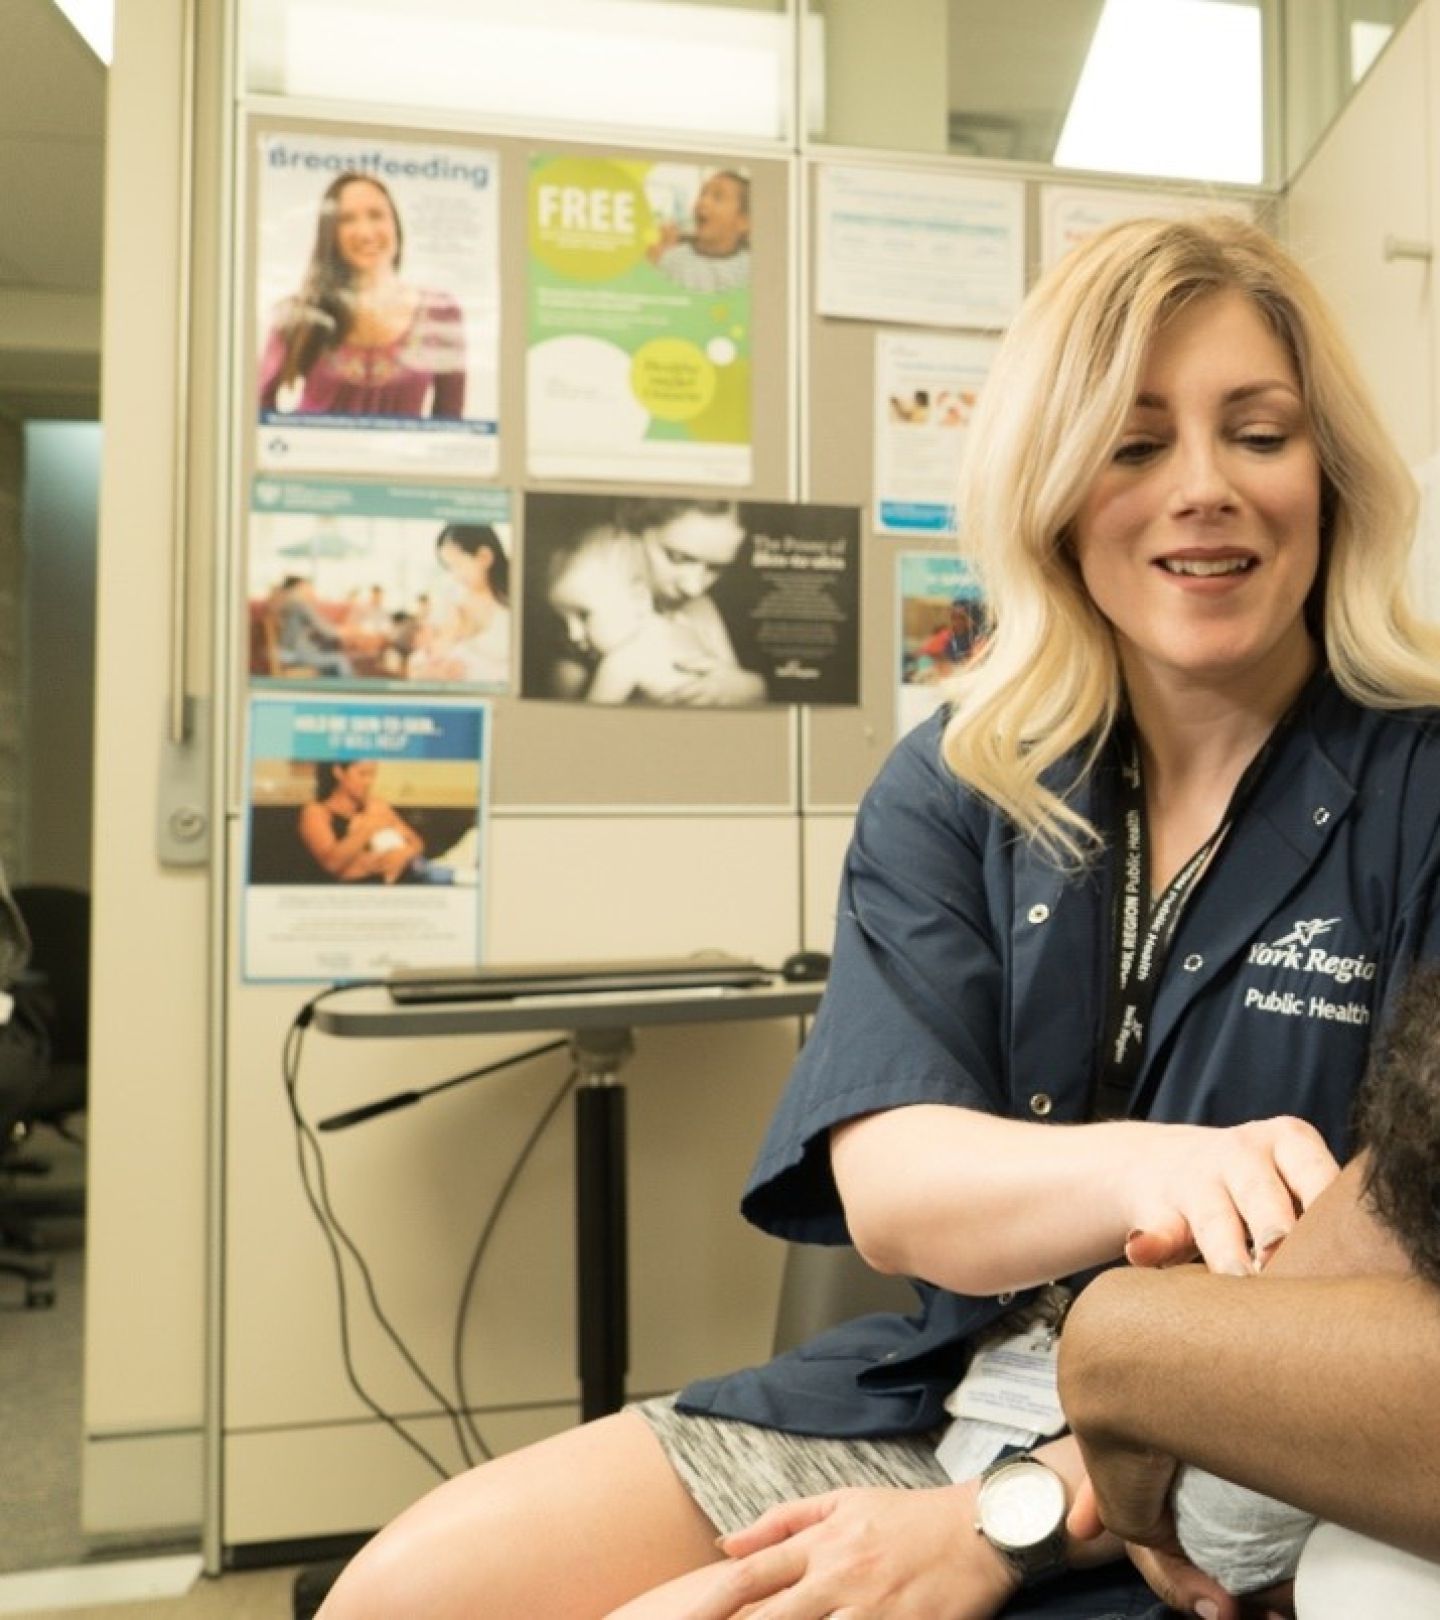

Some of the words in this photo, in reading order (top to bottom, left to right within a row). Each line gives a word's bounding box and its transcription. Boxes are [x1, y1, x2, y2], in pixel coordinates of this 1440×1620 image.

[268, 146, 489, 189] Breastfeeding
[538, 185, 636, 234] FREE
[1125, 852, 1141, 893] Public
[1122, 895, 1139, 949] REGION
[1249, 942, 1303, 969] York
[1303, 948, 1376, 983] Regio
[1244, 987, 1305, 1015] Public
[1308, 996, 1370, 1025] Health
